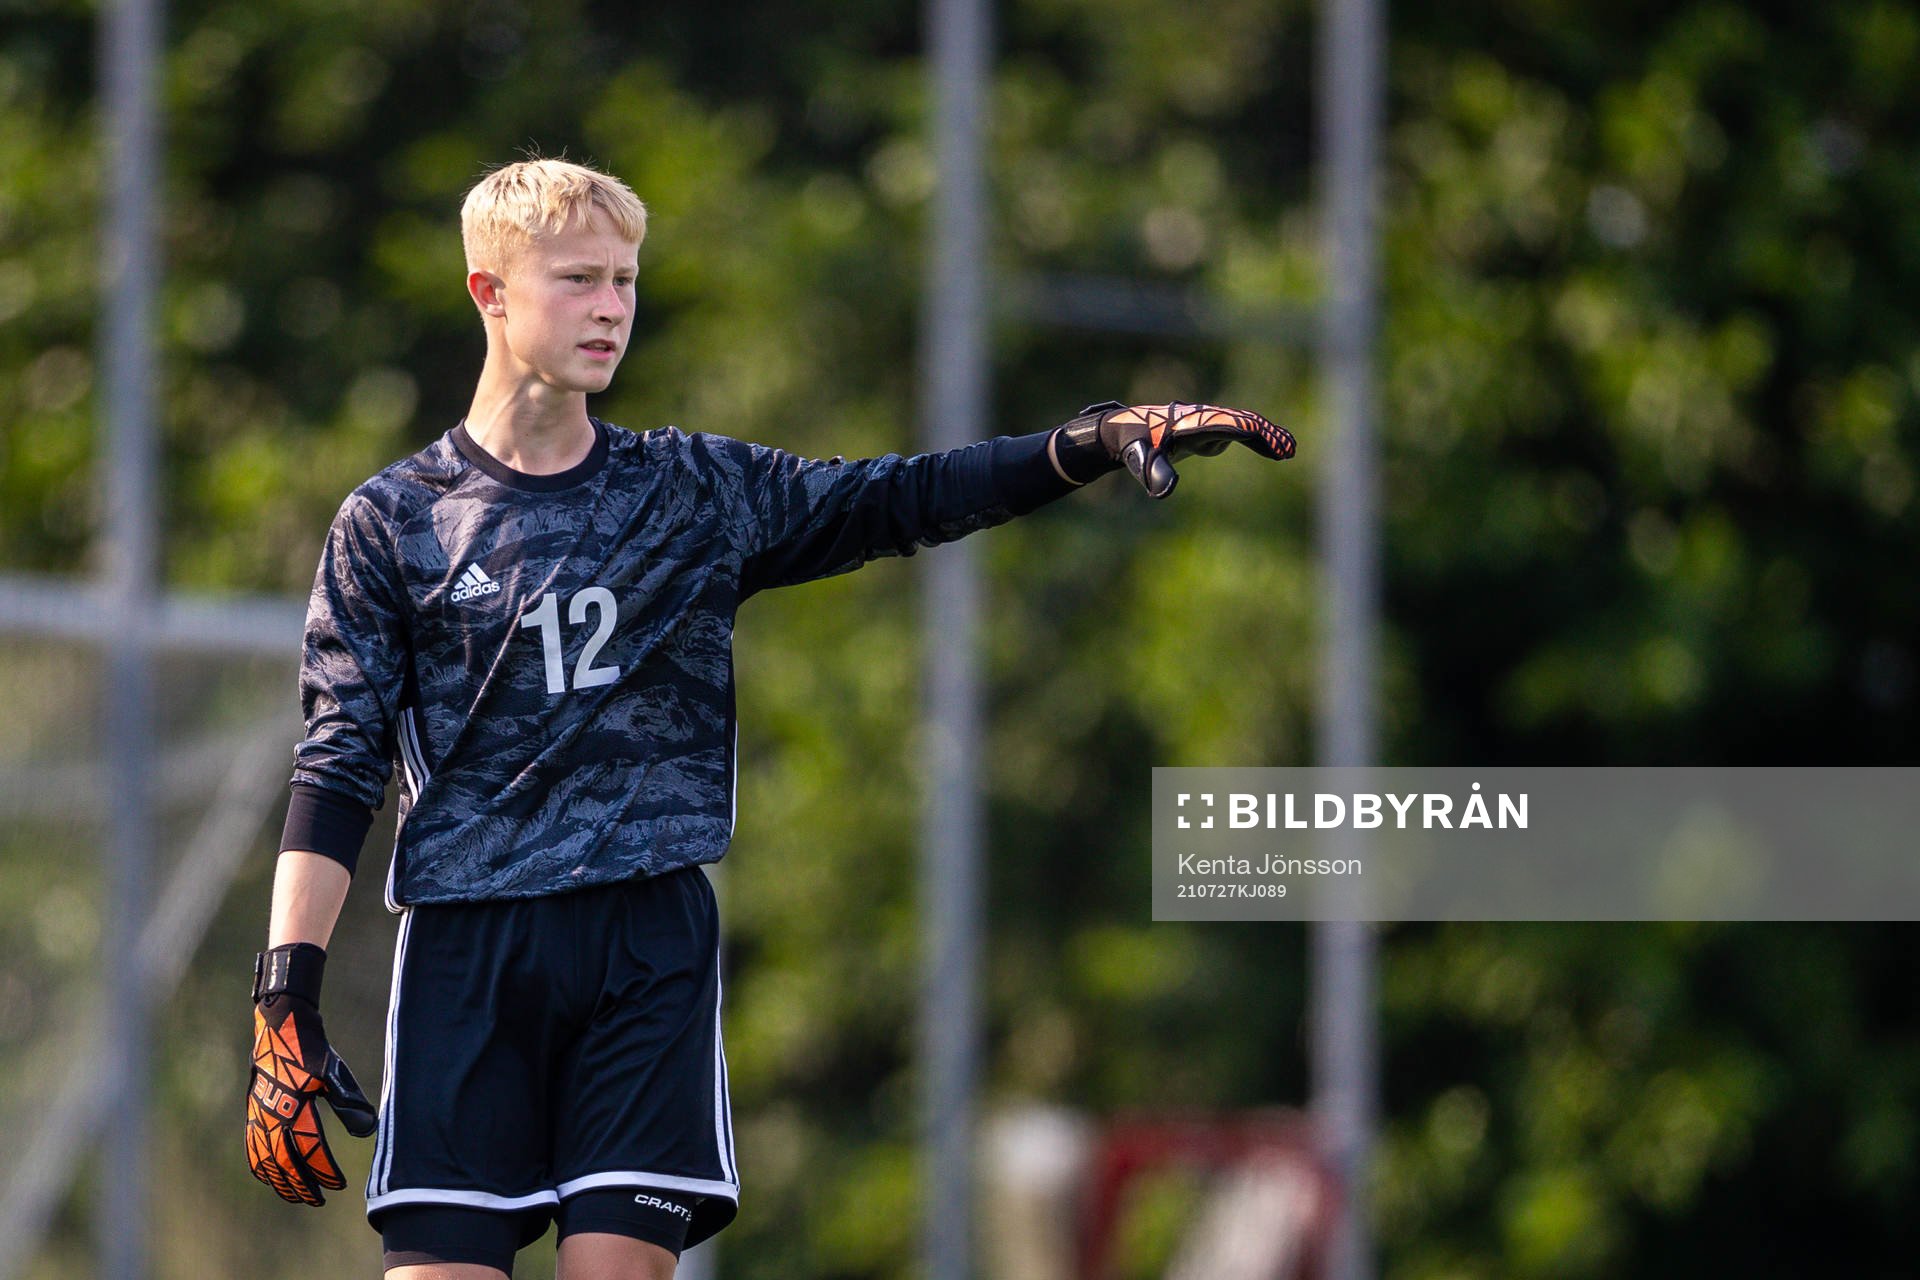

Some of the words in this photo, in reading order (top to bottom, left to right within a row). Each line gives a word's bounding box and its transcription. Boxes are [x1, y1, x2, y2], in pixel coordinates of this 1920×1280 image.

[451, 581, 500, 602] adidas
[520, 586, 621, 694] 12
[634, 1194, 688, 1217] CRAFT
